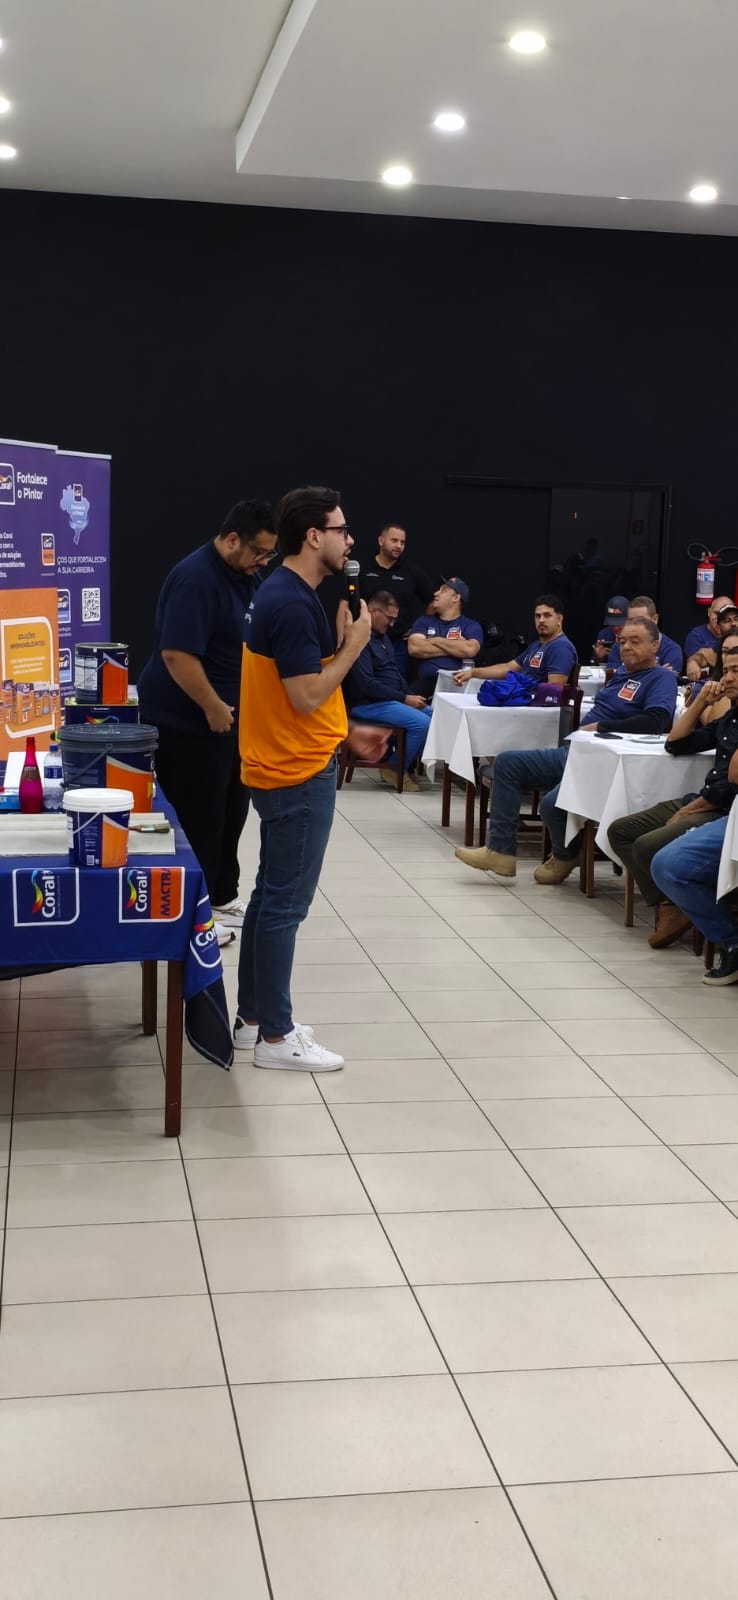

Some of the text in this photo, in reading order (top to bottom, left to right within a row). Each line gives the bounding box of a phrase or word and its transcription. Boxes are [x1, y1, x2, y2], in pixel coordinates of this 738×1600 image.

[17, 472, 48, 485] Fortalece
[17, 488, 43, 500] o Pintor
[68, 556, 77, 564] QUE
[62, 566, 71, 574] SUA
[72, 566, 95, 574] CARREIRA
[42, 876, 56, 918] Coral
[135, 876, 148, 912] Coral
